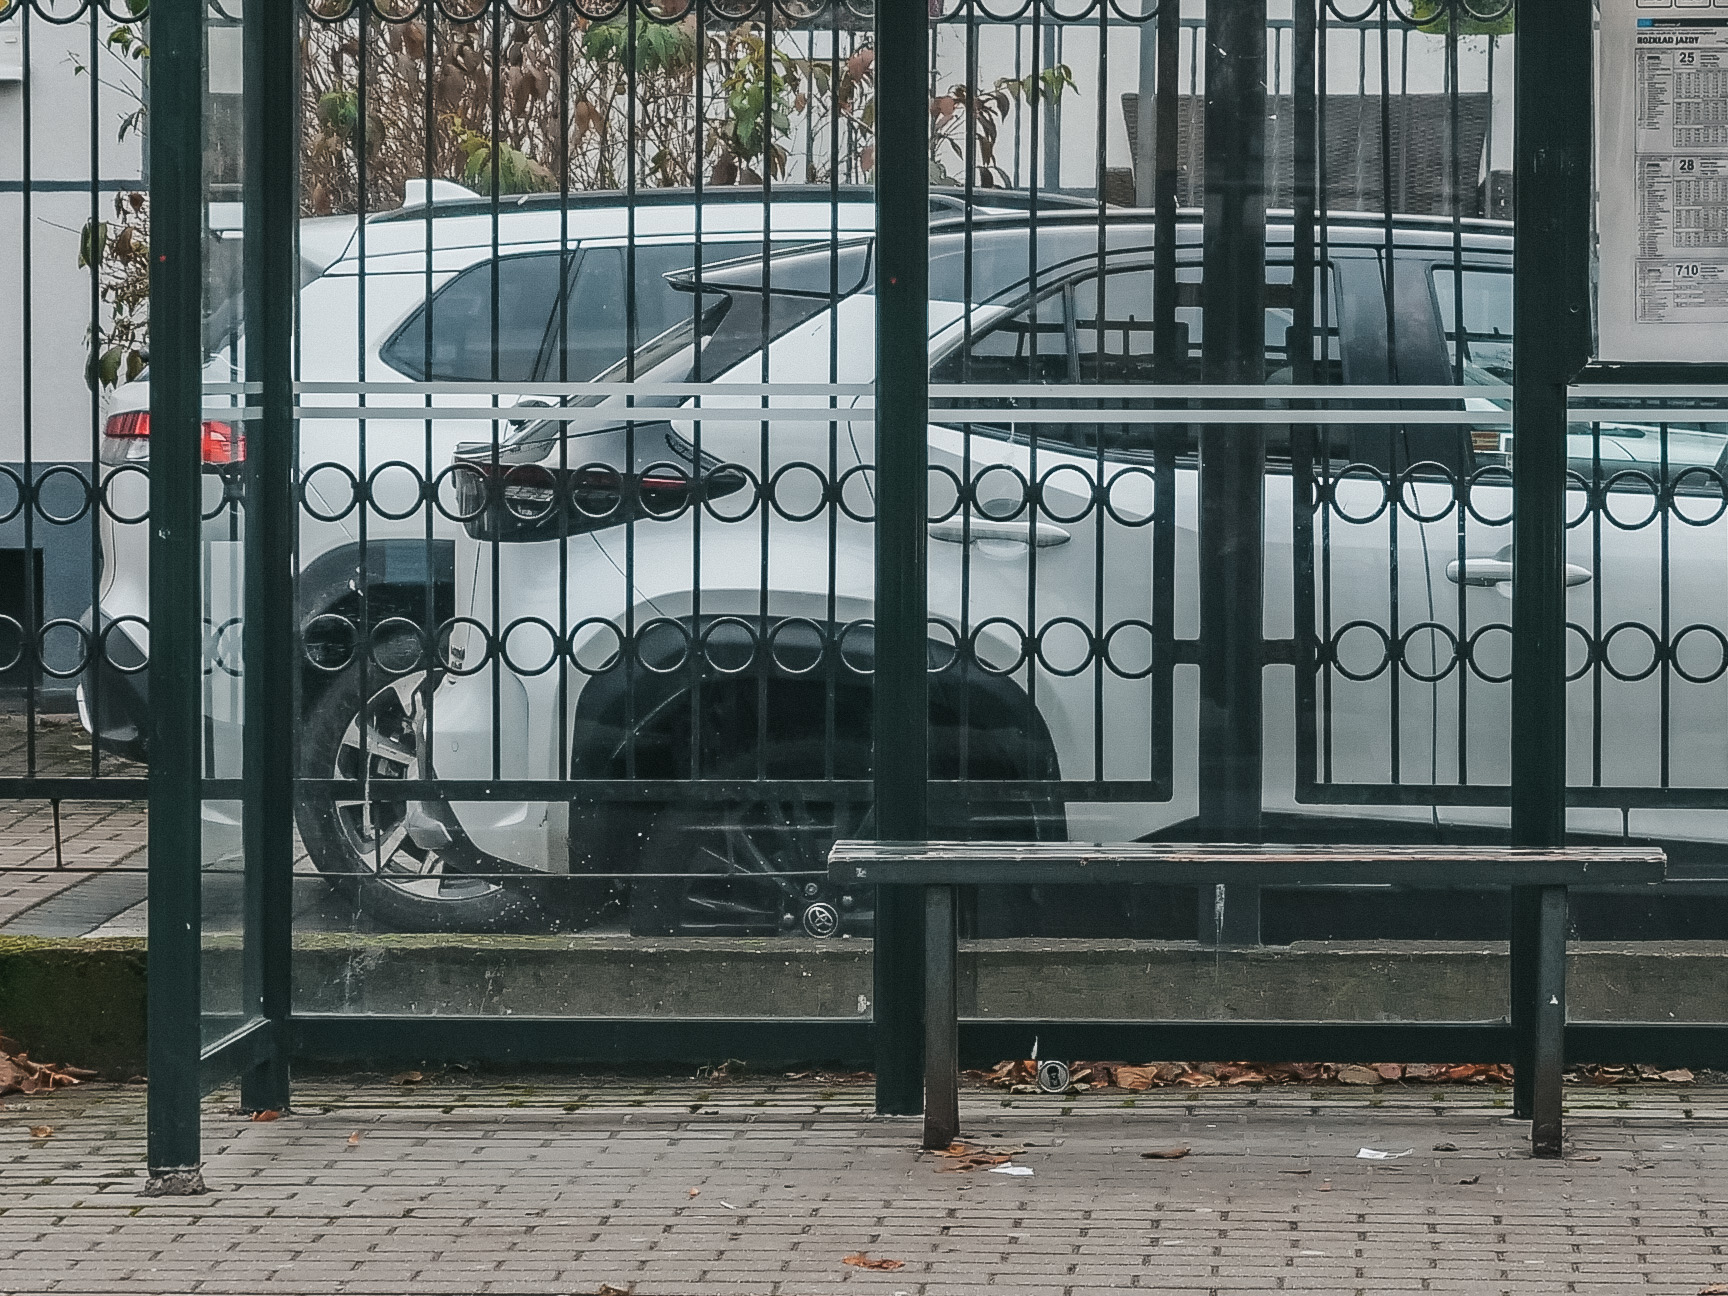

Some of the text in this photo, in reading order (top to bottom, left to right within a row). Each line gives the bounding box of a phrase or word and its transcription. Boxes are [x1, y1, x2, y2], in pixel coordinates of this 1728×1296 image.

[1679, 51, 1695, 63] 25
[1679, 159, 1695, 171] 28
[1676, 265, 1699, 276] 710
